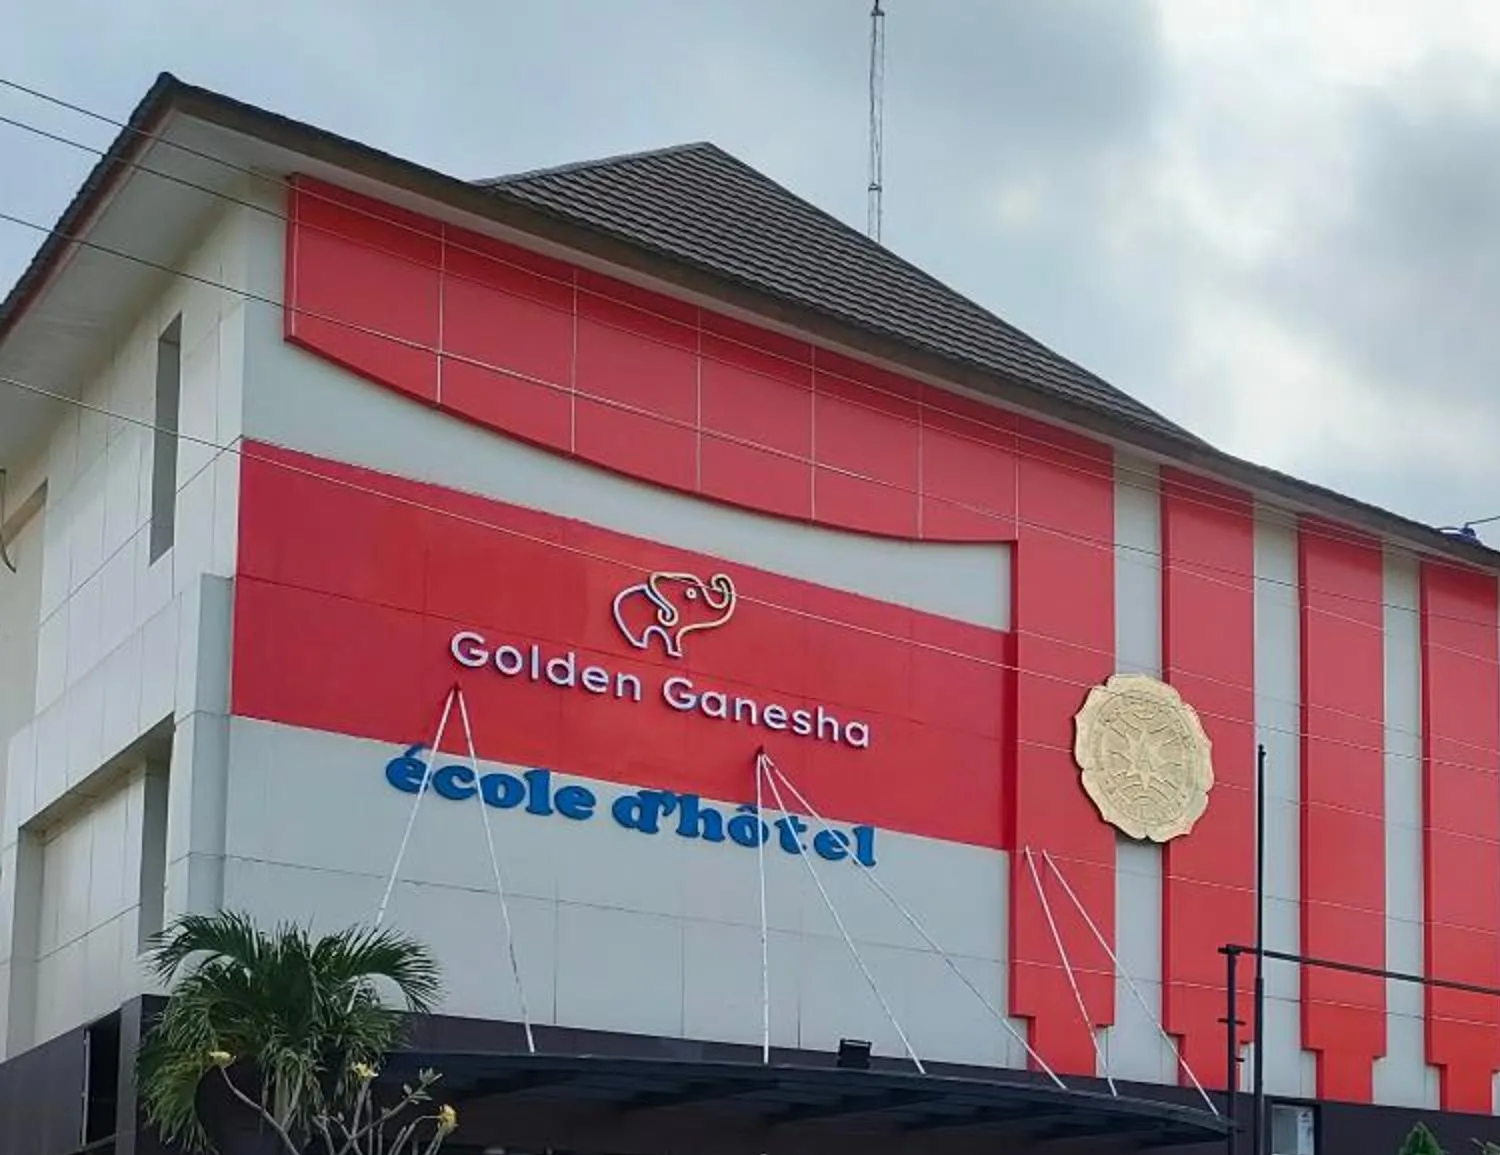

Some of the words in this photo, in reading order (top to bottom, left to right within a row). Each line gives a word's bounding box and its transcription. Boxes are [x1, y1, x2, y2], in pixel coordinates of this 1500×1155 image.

[451, 631, 642, 702] Golden
[662, 676, 871, 748] Ganesha
[386, 743, 596, 821] école
